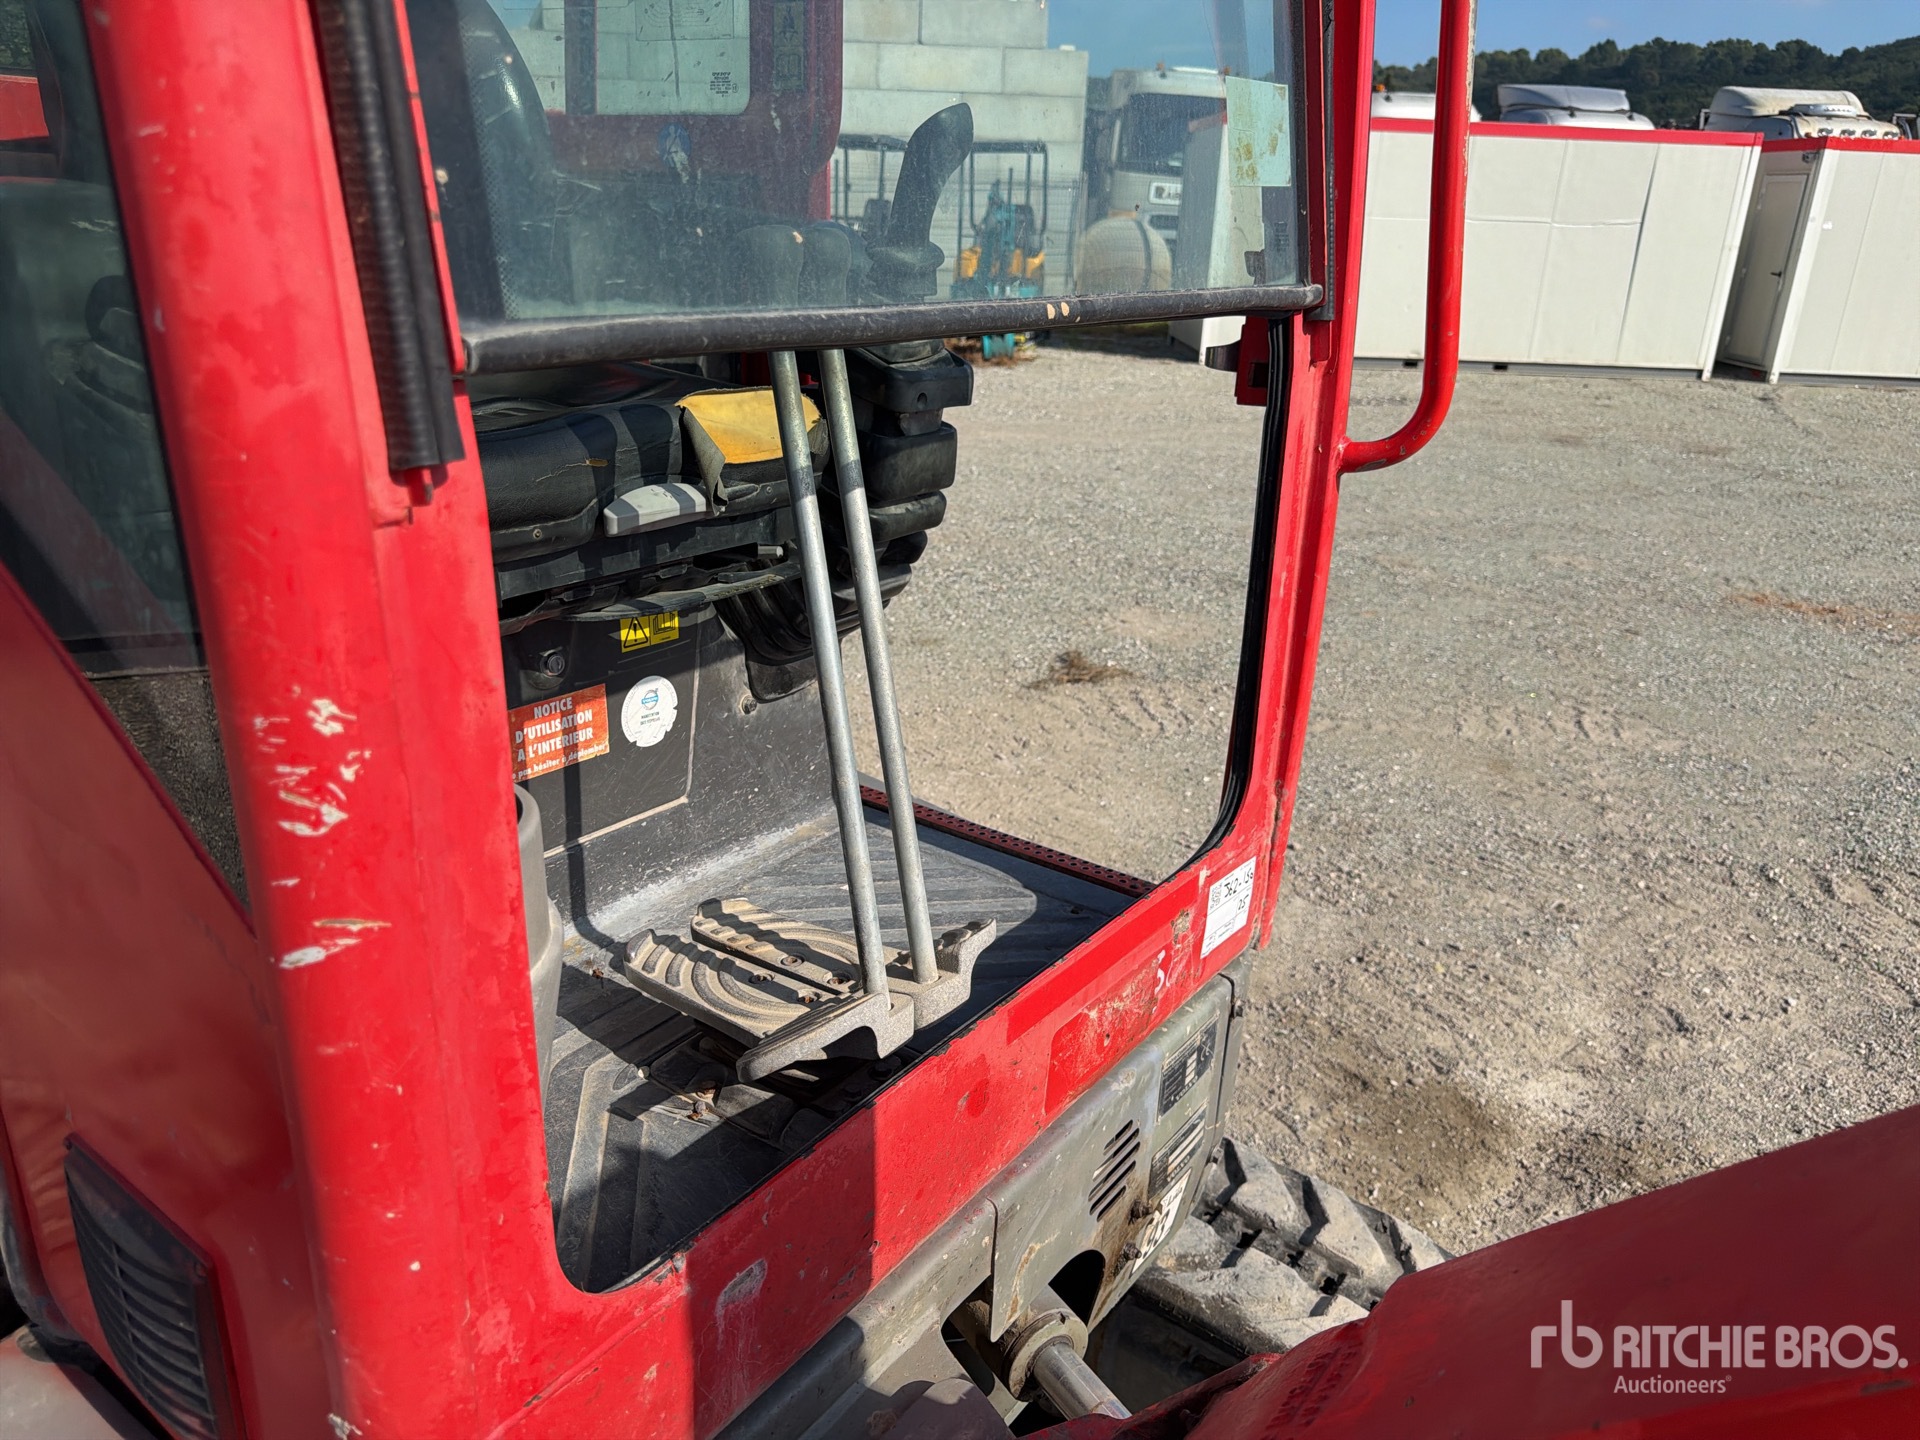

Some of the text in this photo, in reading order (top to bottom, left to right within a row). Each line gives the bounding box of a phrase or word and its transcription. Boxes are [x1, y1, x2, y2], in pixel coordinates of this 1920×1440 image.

[534, 697, 573, 719] NOTICE
[515, 711, 593, 744] D'UTILISATION
[517, 728, 593, 762] A L'INTERIEUR
[518, 765, 533, 779] pas
[533, 758, 560, 774] hésiter
[1175, 1075, 1199, 1101] VOLVO
